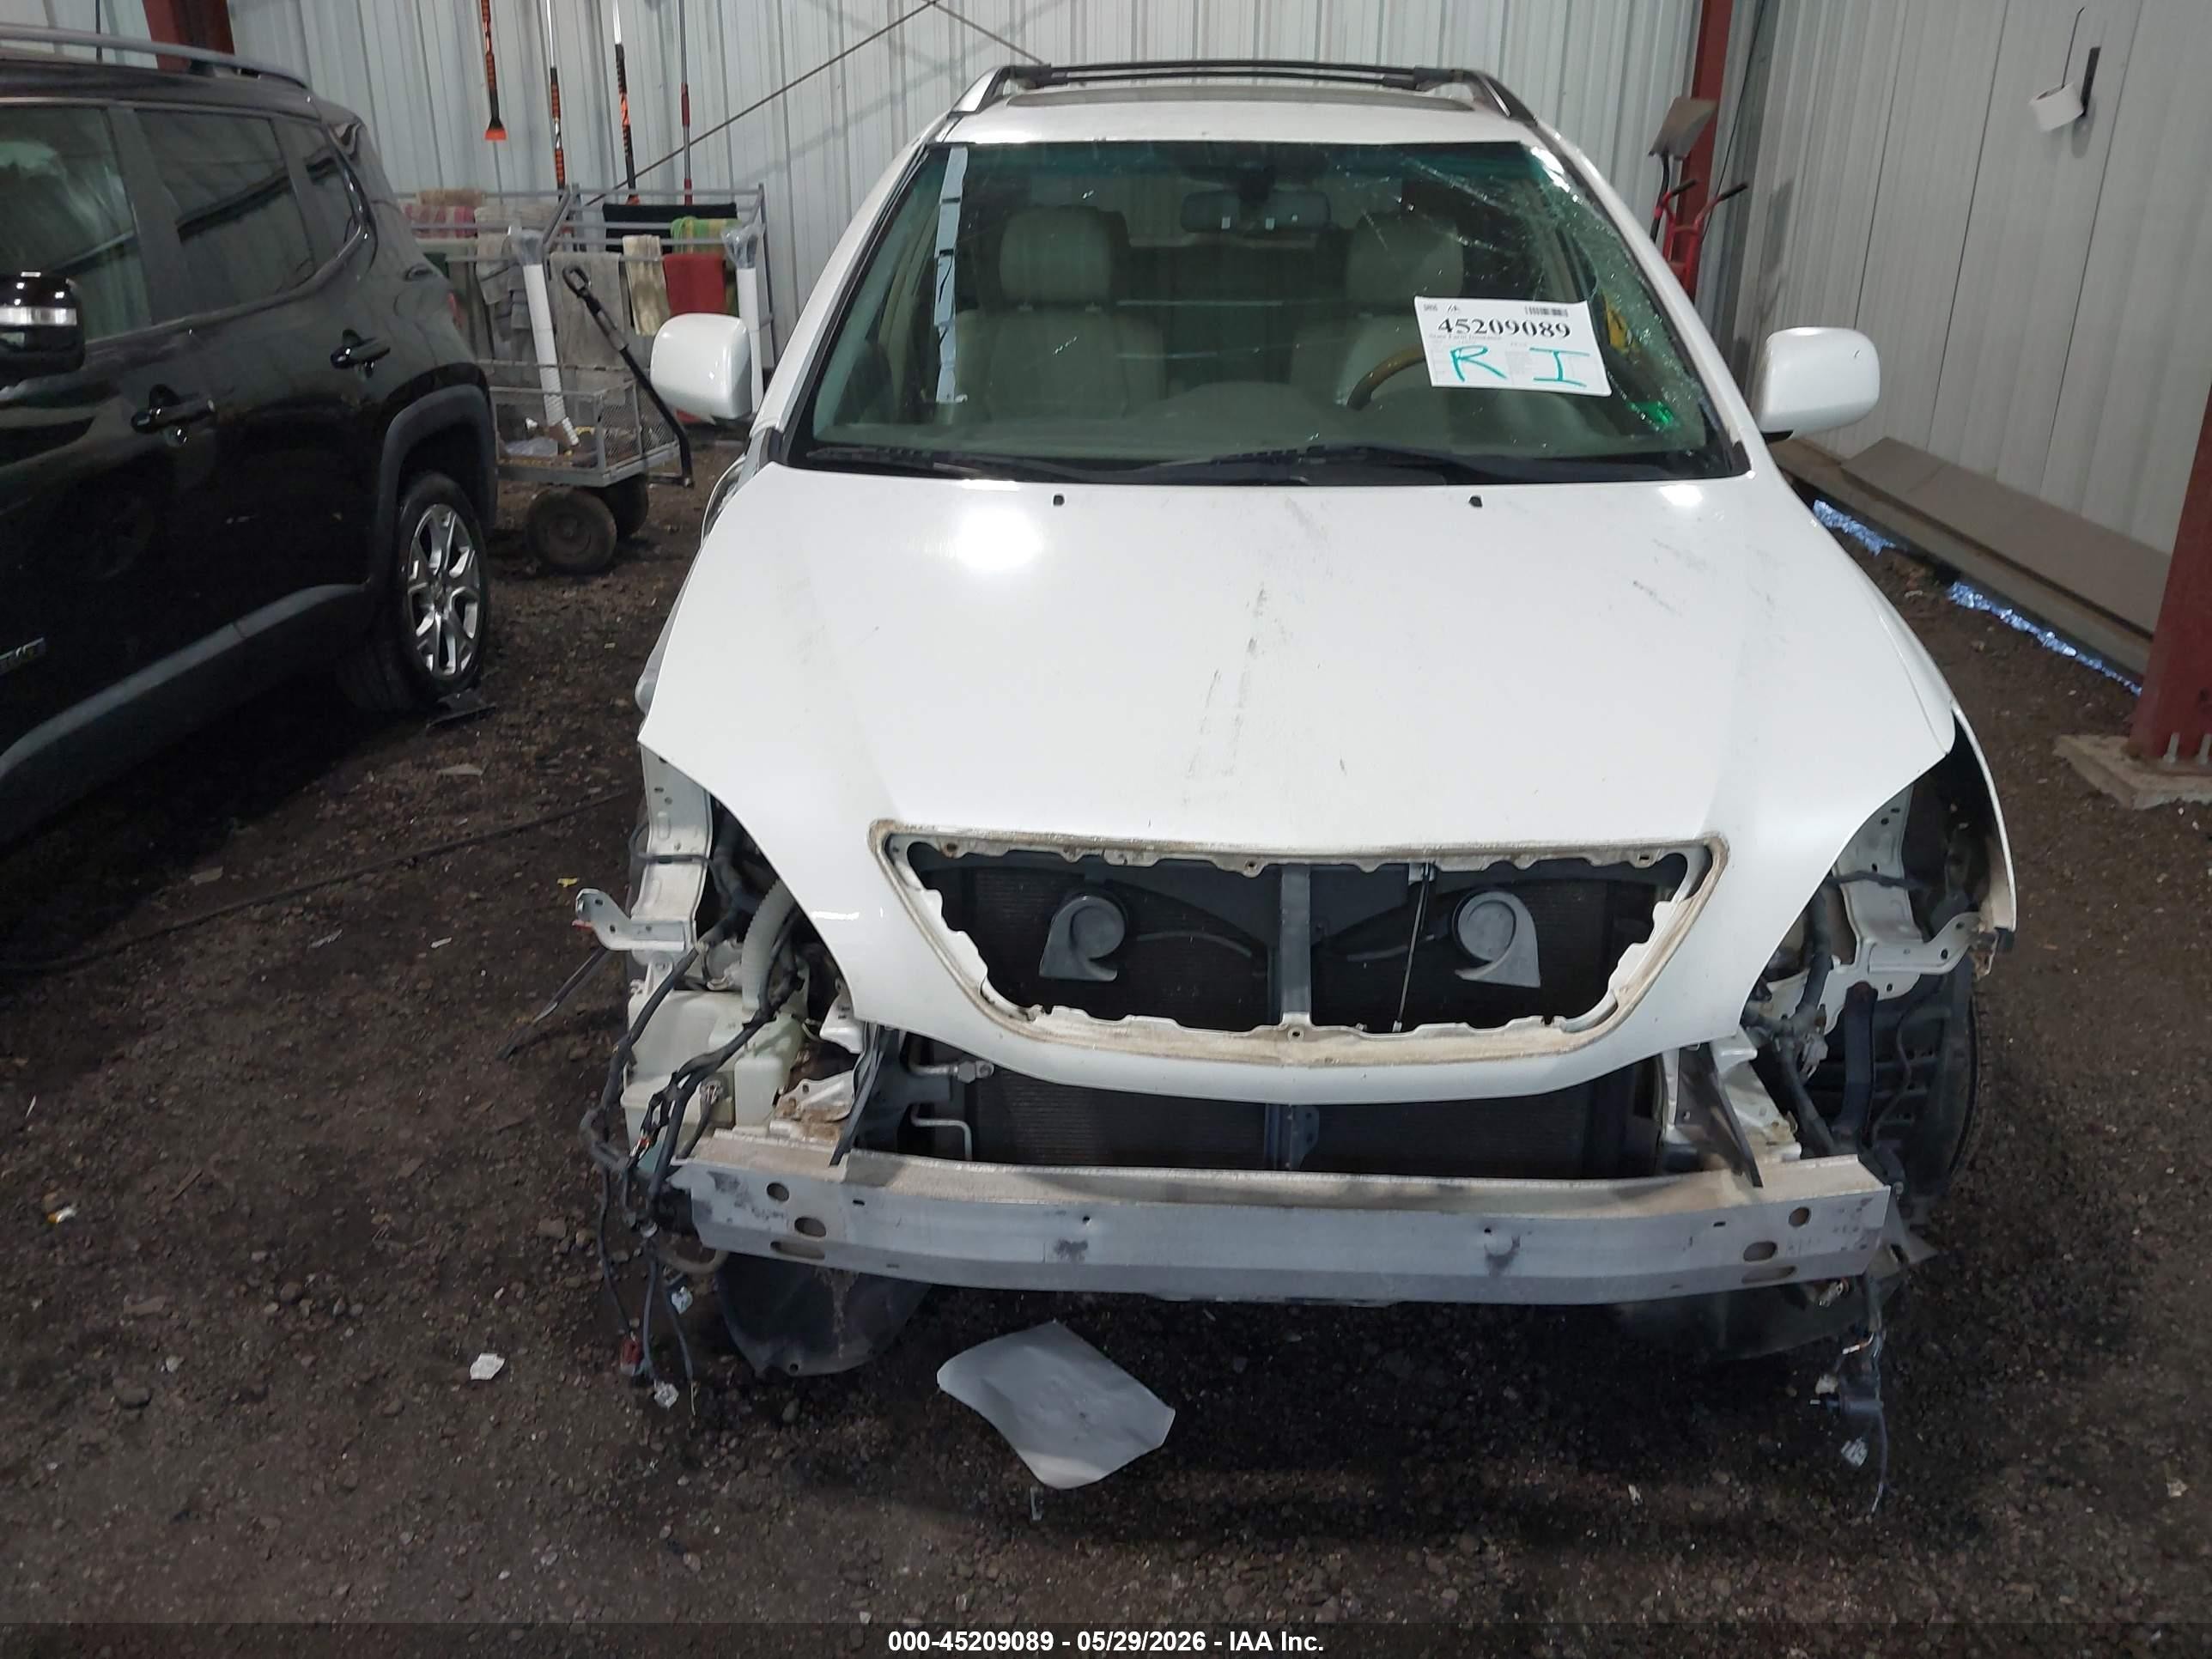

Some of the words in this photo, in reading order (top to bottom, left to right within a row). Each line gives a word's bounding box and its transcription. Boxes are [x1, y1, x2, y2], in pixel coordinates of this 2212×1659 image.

[1438, 317, 1571, 338] 45209089
[1449, 345, 1507, 382] R
[1529, 347, 1590, 387] I
